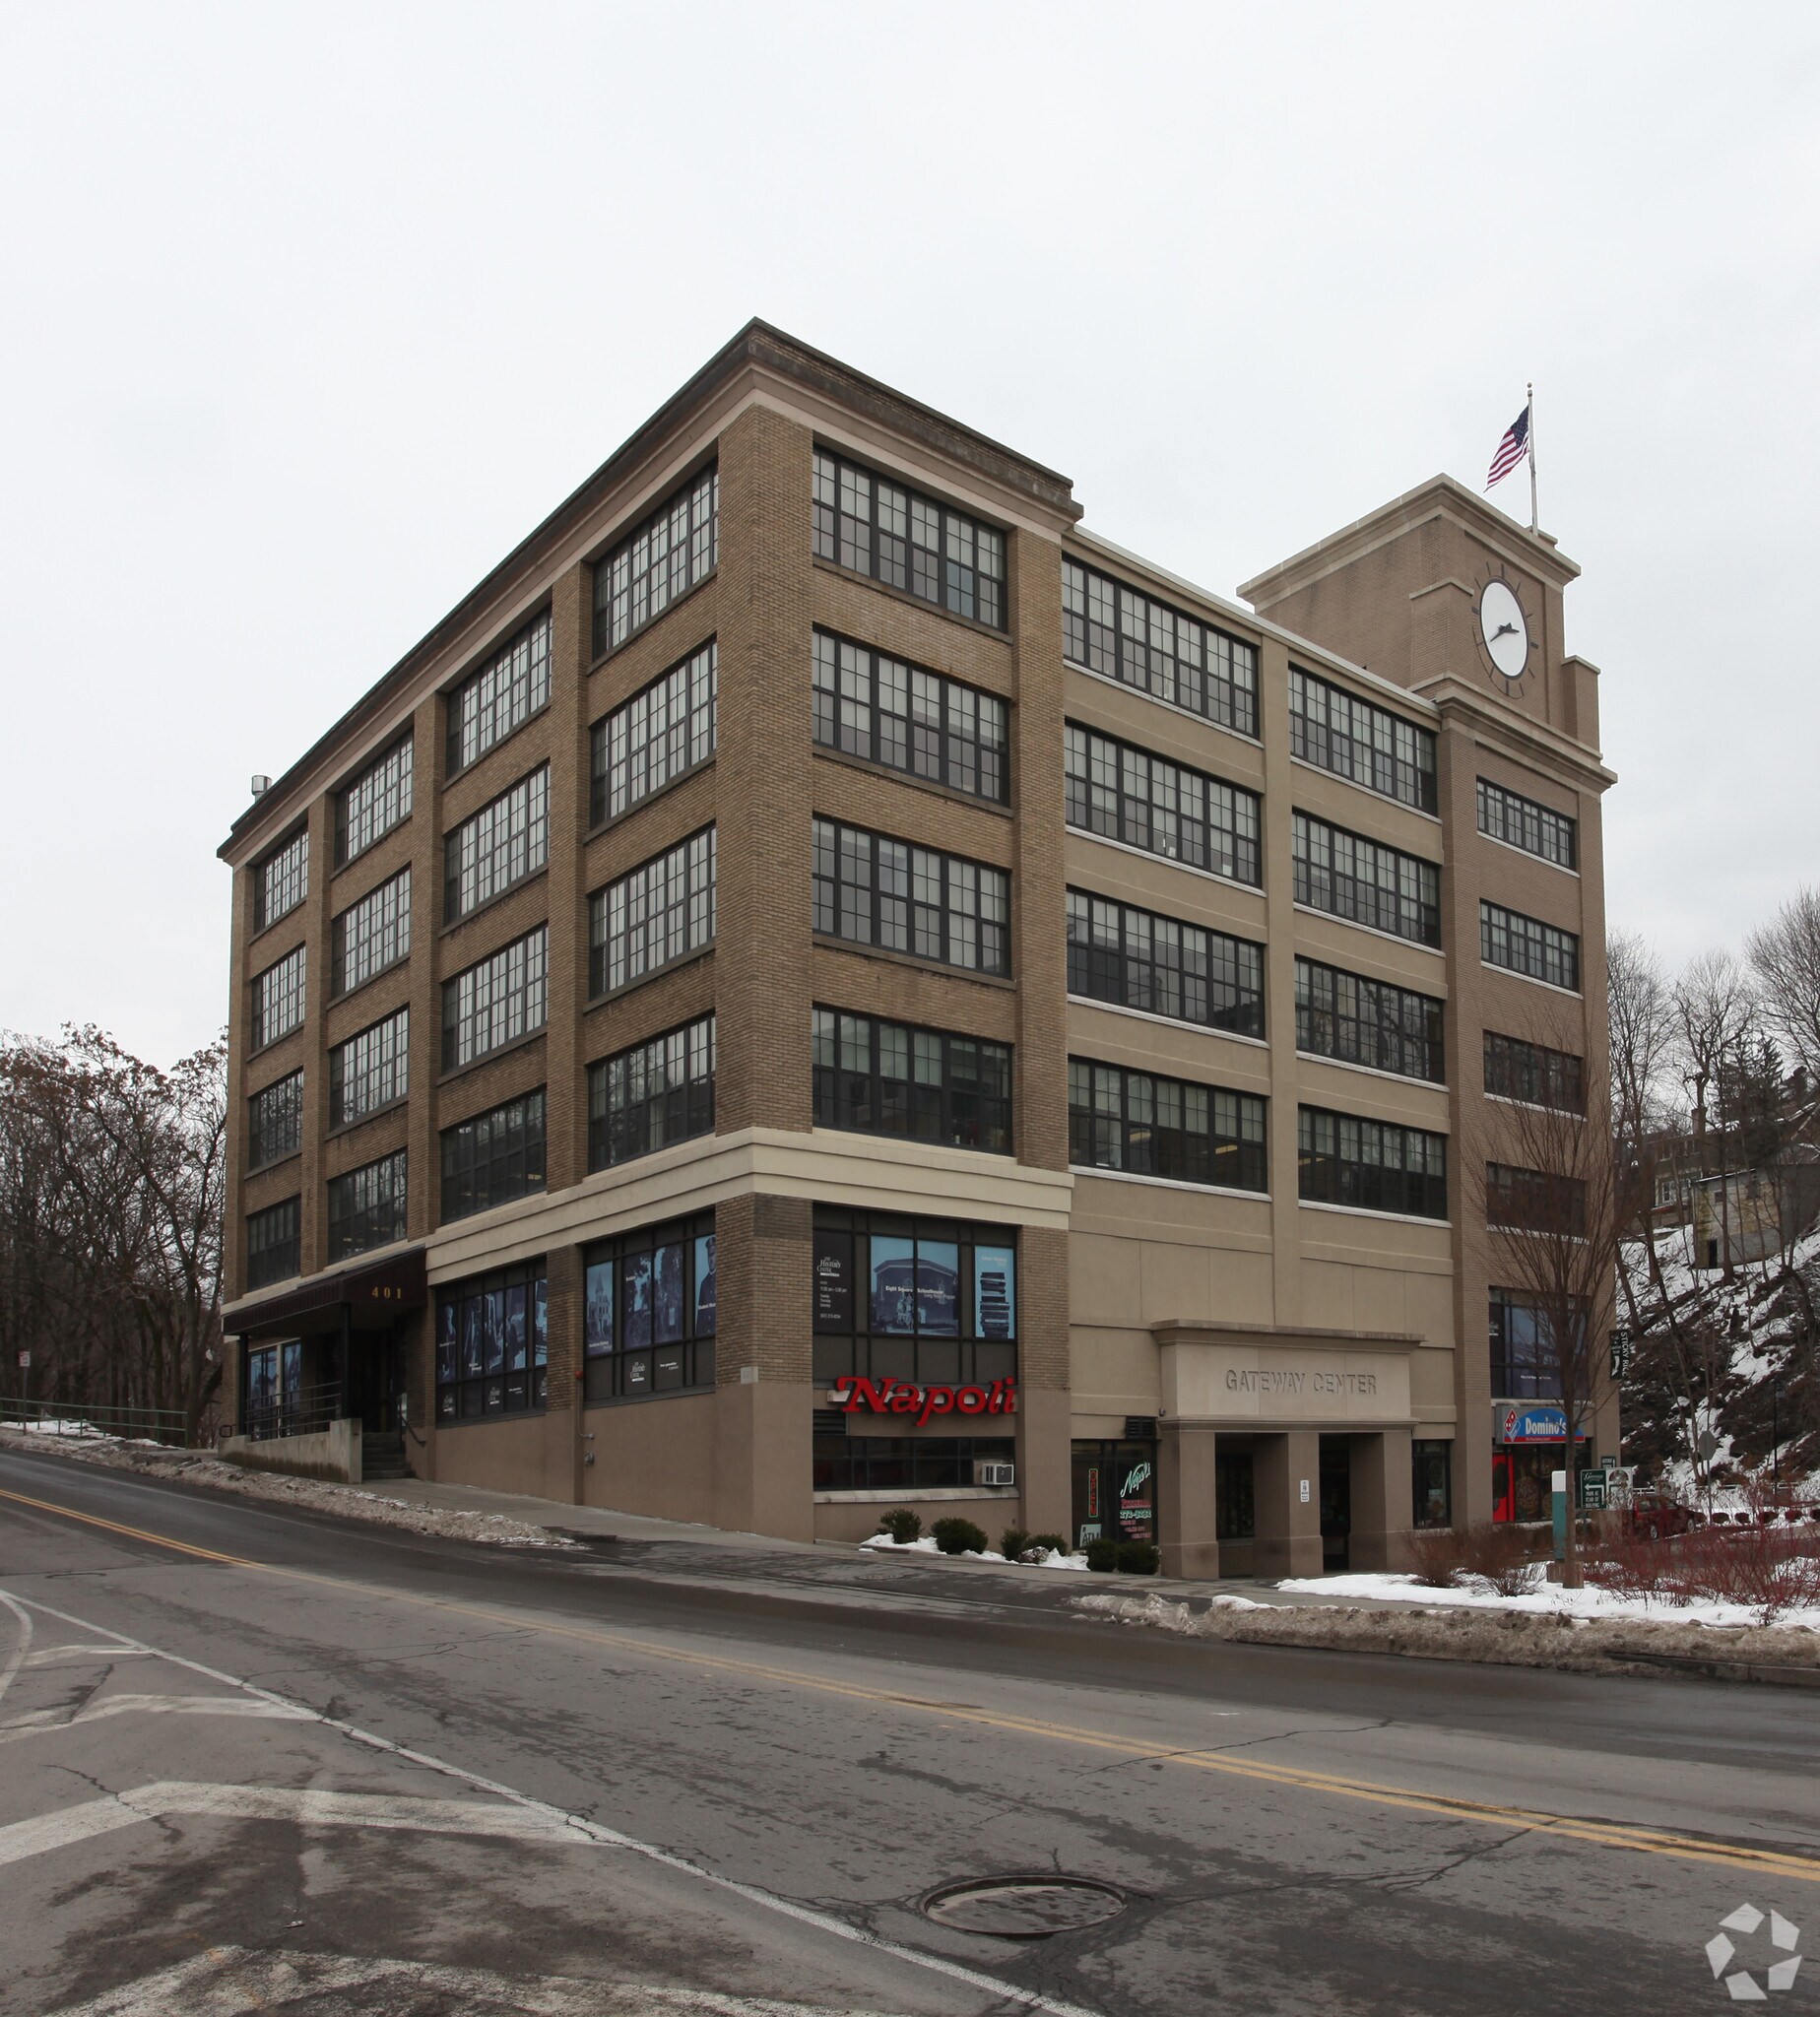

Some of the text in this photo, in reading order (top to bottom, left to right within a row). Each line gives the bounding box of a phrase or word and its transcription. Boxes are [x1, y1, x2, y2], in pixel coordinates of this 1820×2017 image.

[371, 1286, 402, 1299] 401
[1620, 1332, 1629, 1357] STICKY
[1225, 1369, 1377, 1396] GATEWAY CENTER
[837, 1376, 1015, 1427] Napoli
[1526, 1416, 1567, 1435] Domino's
